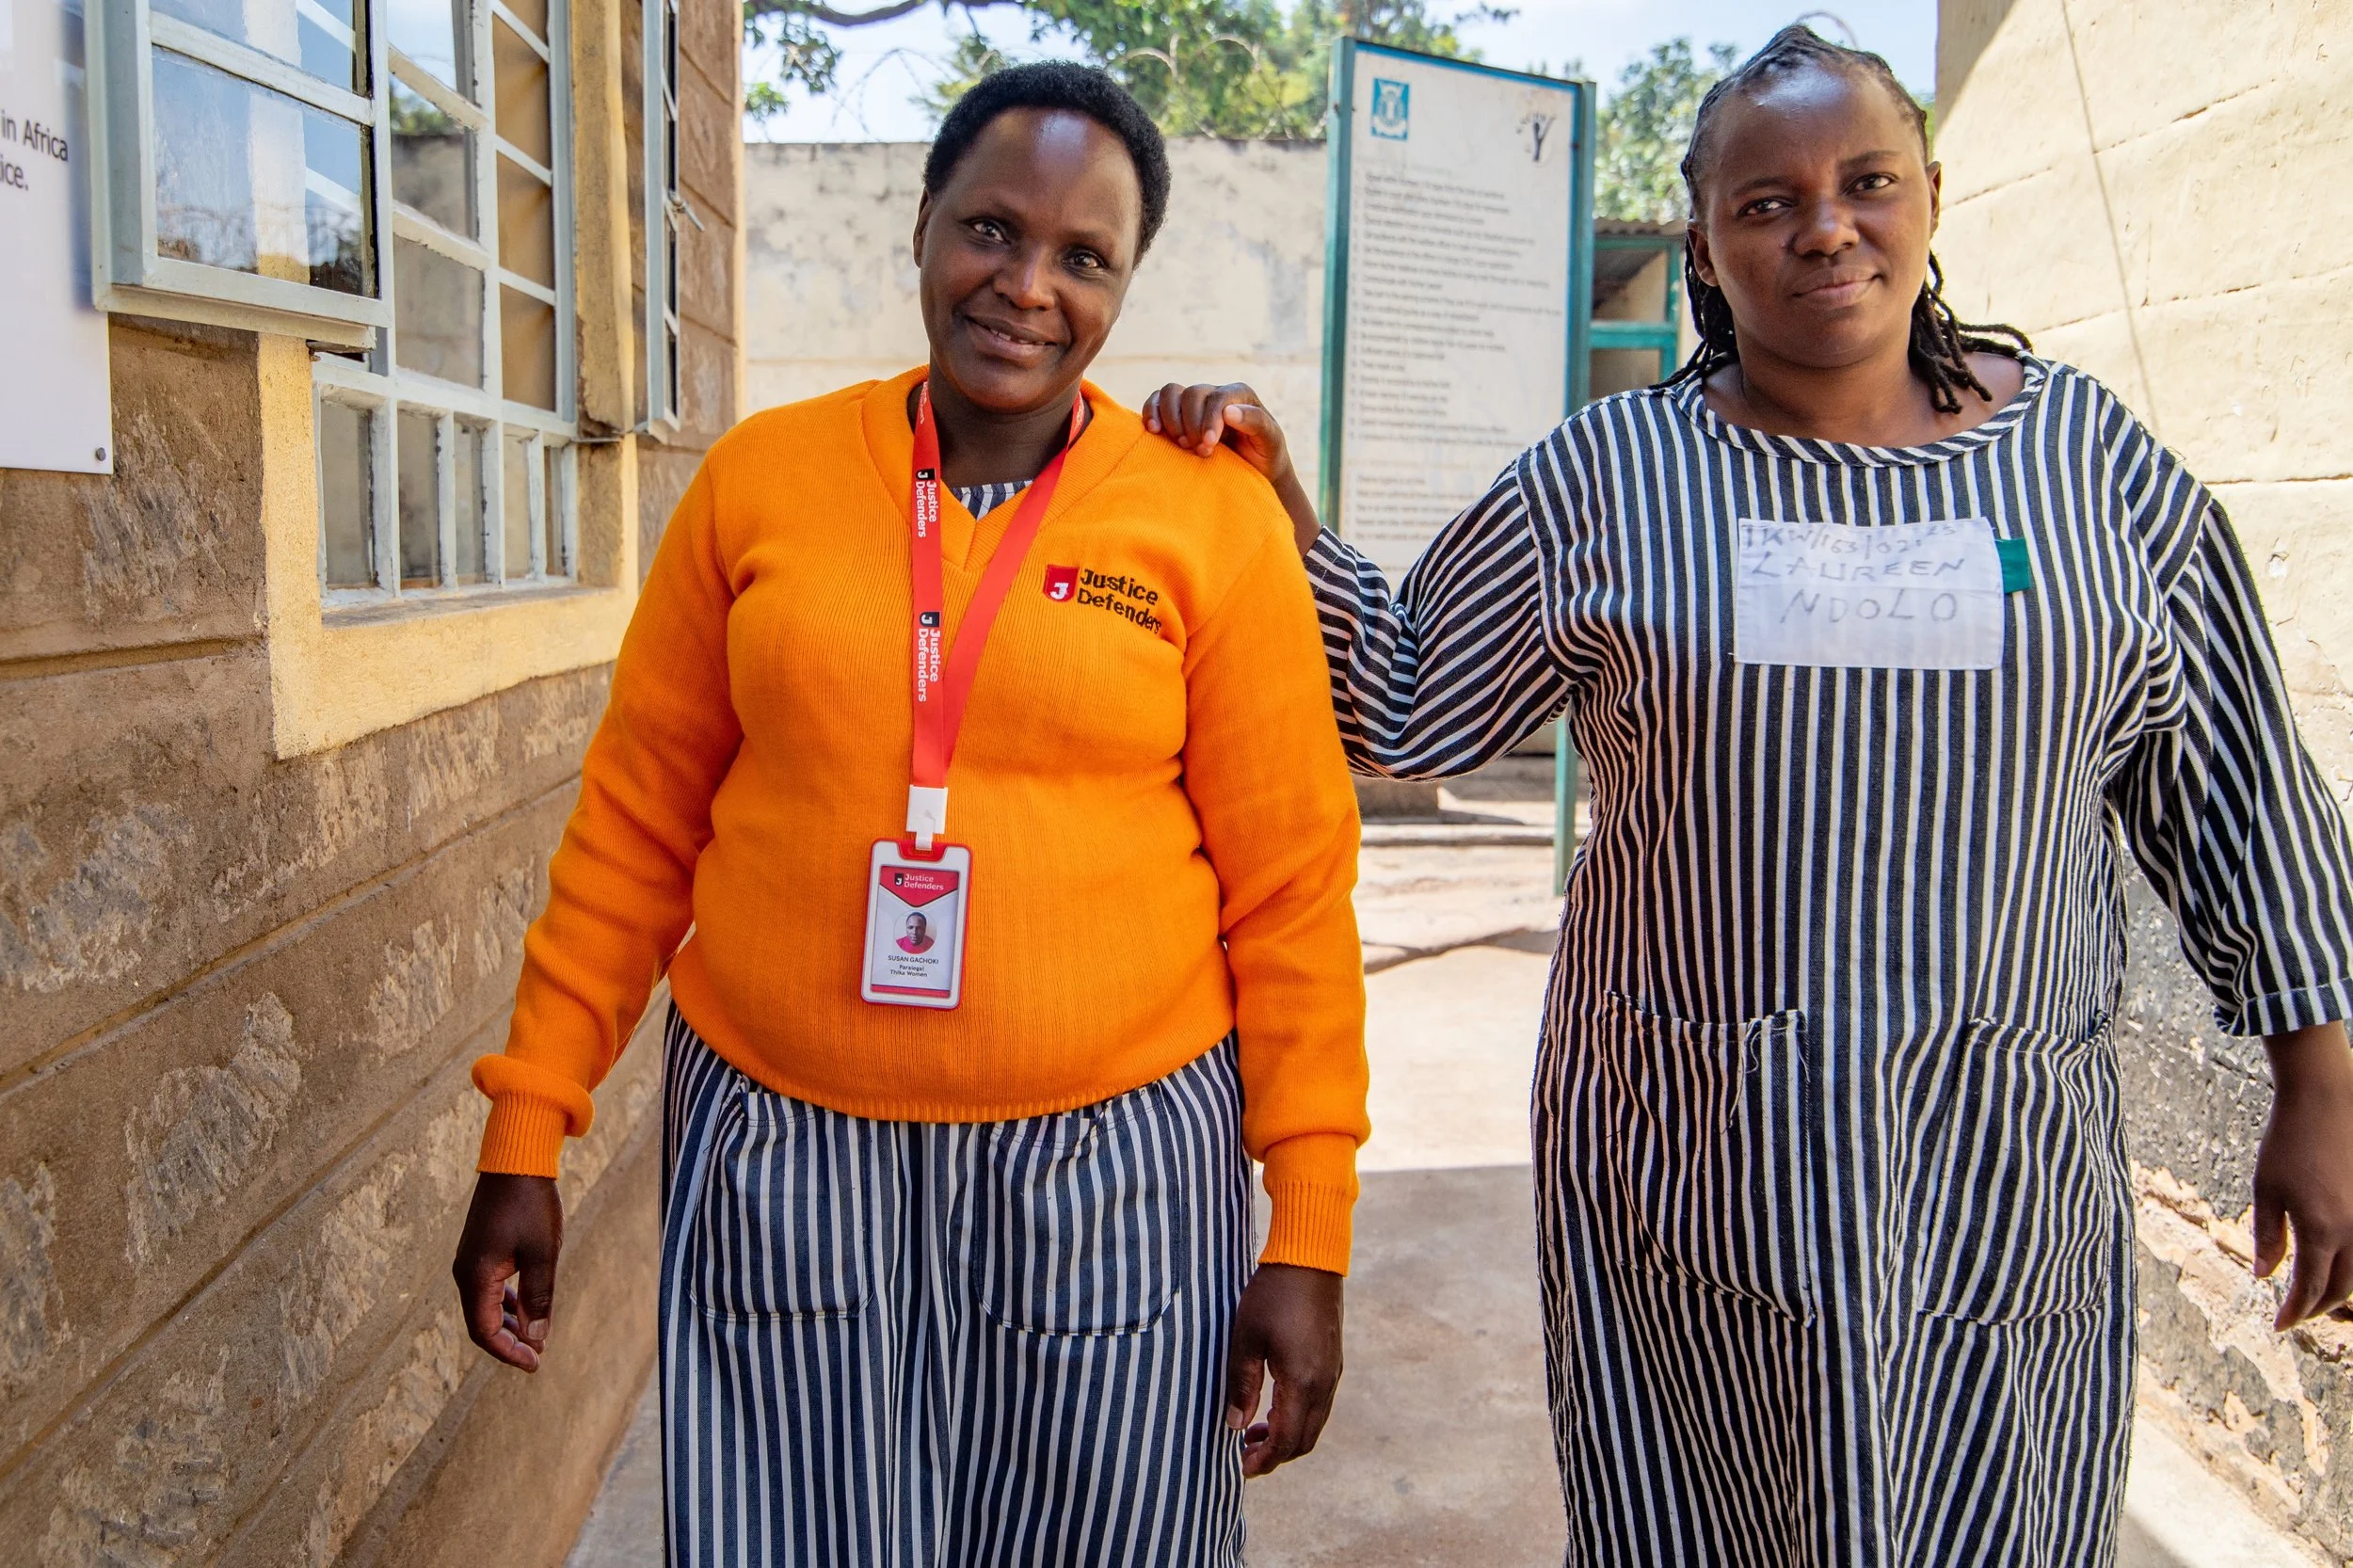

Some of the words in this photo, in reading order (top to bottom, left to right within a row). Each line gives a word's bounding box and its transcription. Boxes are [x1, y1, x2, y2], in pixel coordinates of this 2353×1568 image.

[2, 109, 17, 142] in
[23, 119, 69, 162] Africa
[0, 152, 29, 191] ice.
[916, 481, 927, 537] Defenders
[926, 481, 938, 522] Justice
[1752, 551, 1965, 582] LAUREEN
[1080, 568, 1159, 605] Justice
[1780, 588, 1960, 624] NDOLO
[1077, 587, 1162, 634] Defenders
[918, 628, 929, 702] Defenders
[929, 629, 941, 682] Justice
[904, 873, 934, 883] Justice
[904, 881, 944, 891] Defenders
[909, 956, 939, 965] GACHOKI
